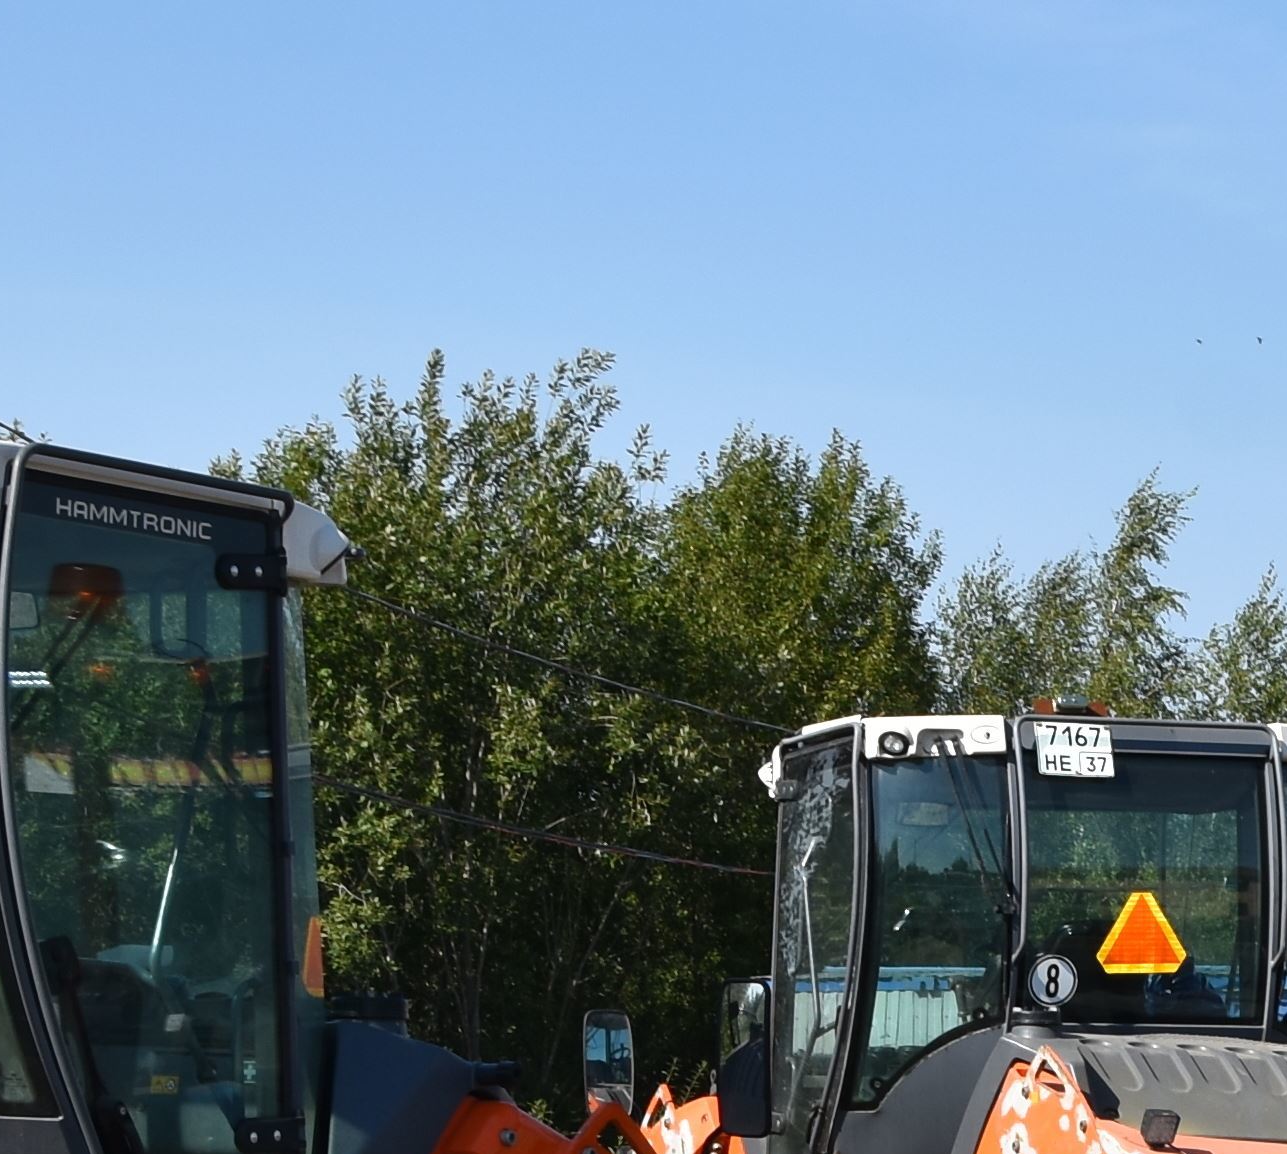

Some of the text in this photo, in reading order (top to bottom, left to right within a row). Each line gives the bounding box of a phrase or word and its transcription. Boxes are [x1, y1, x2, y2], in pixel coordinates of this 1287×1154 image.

[55, 497, 212, 540] HAMMTRONIC
[1045, 725, 1100, 747] 7167
[1086, 756, 1107, 772] 37
[1045, 963, 1060, 998] 8
